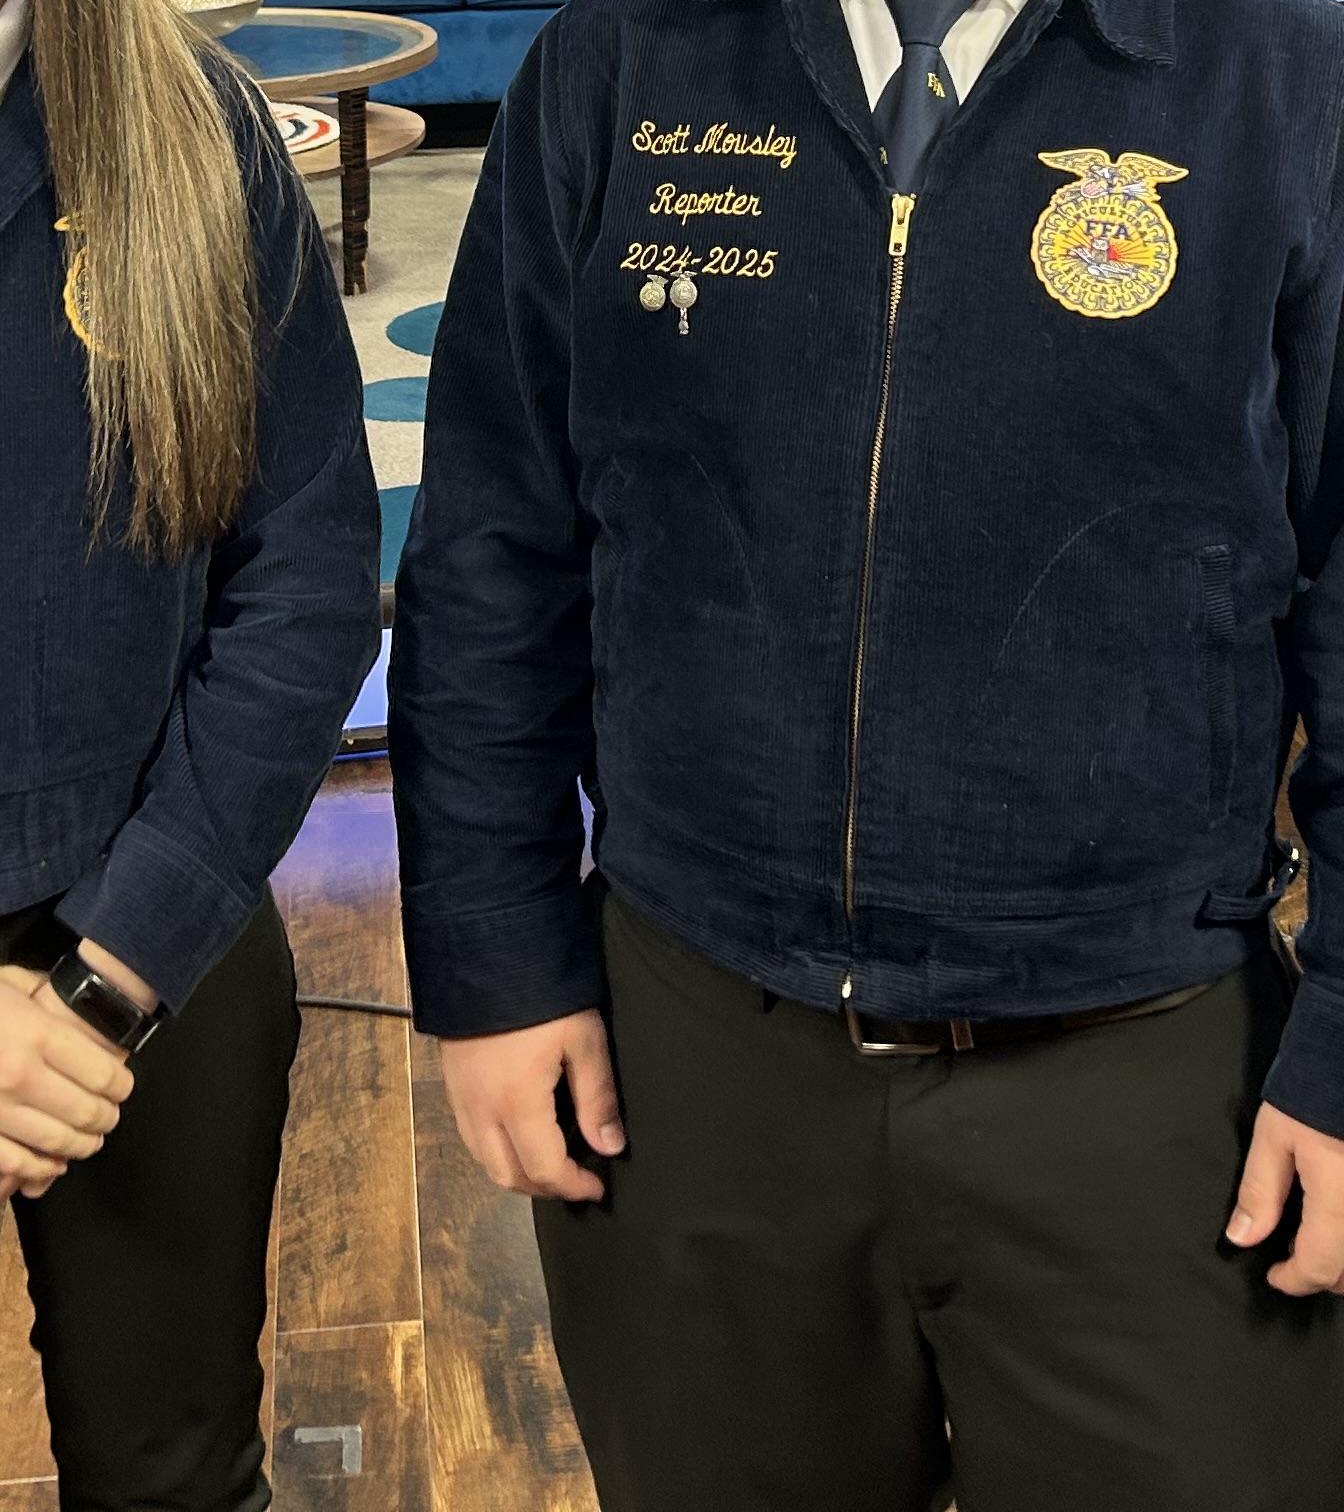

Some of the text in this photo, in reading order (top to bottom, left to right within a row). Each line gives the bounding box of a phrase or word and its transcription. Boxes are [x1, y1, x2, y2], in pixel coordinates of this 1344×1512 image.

[632, 120, 797, 169] Scott Mousley
[649, 183, 762, 226] Reporter
[1085, 219, 1133, 241] FFA
[620, 242, 778, 278] 2024-2025
